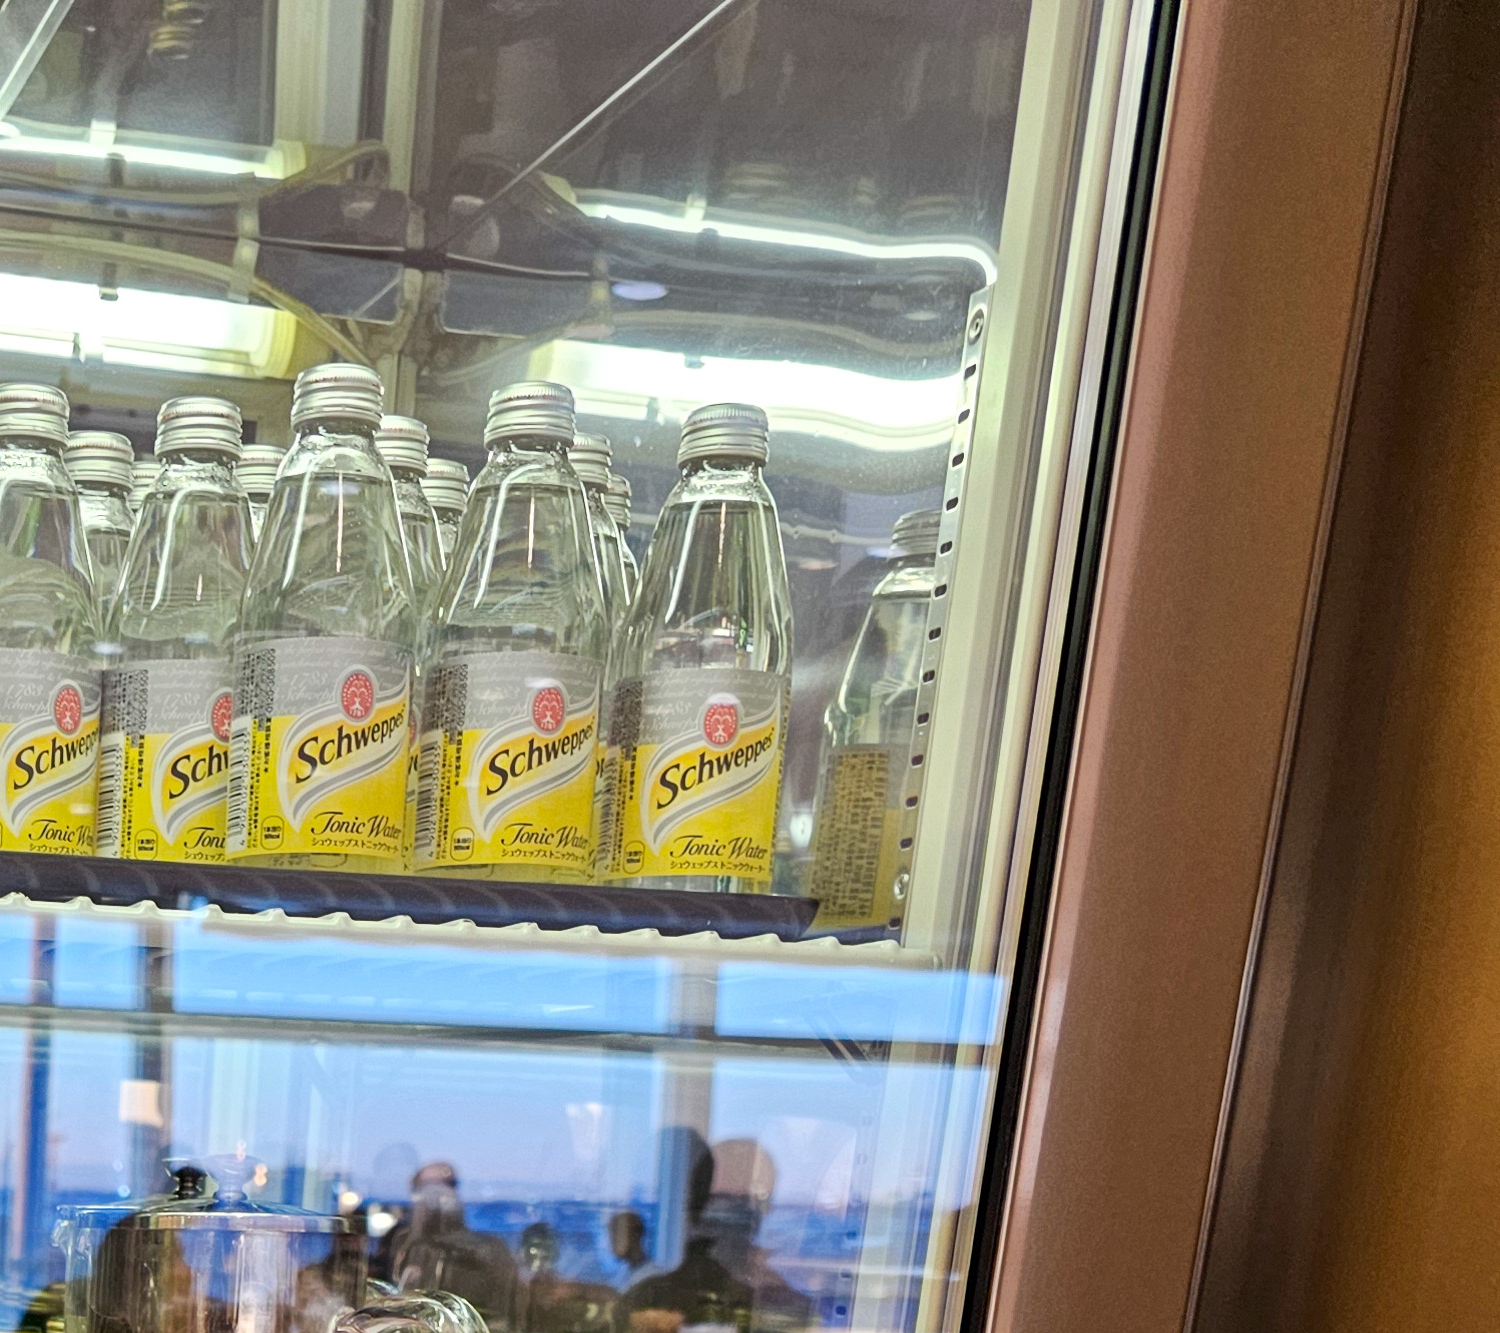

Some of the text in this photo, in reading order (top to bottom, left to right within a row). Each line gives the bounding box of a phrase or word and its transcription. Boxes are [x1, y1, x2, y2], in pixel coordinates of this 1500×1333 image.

[296, 713, 404, 784] Schweppes
[486, 725, 593, 796] Schweppes
[657, 734, 773, 810] Schweppes
[29, 819, 75, 840] Tonic
[184, 827, 226, 849] Toni
[311, 811, 366, 835] Tonic
[367, 815, 402, 839] Water
[501, 823, 554, 847] Tonic
[556, 825, 589, 848] Water
[670, 835, 725, 858] Tonic
[728, 837, 768, 860] Water
